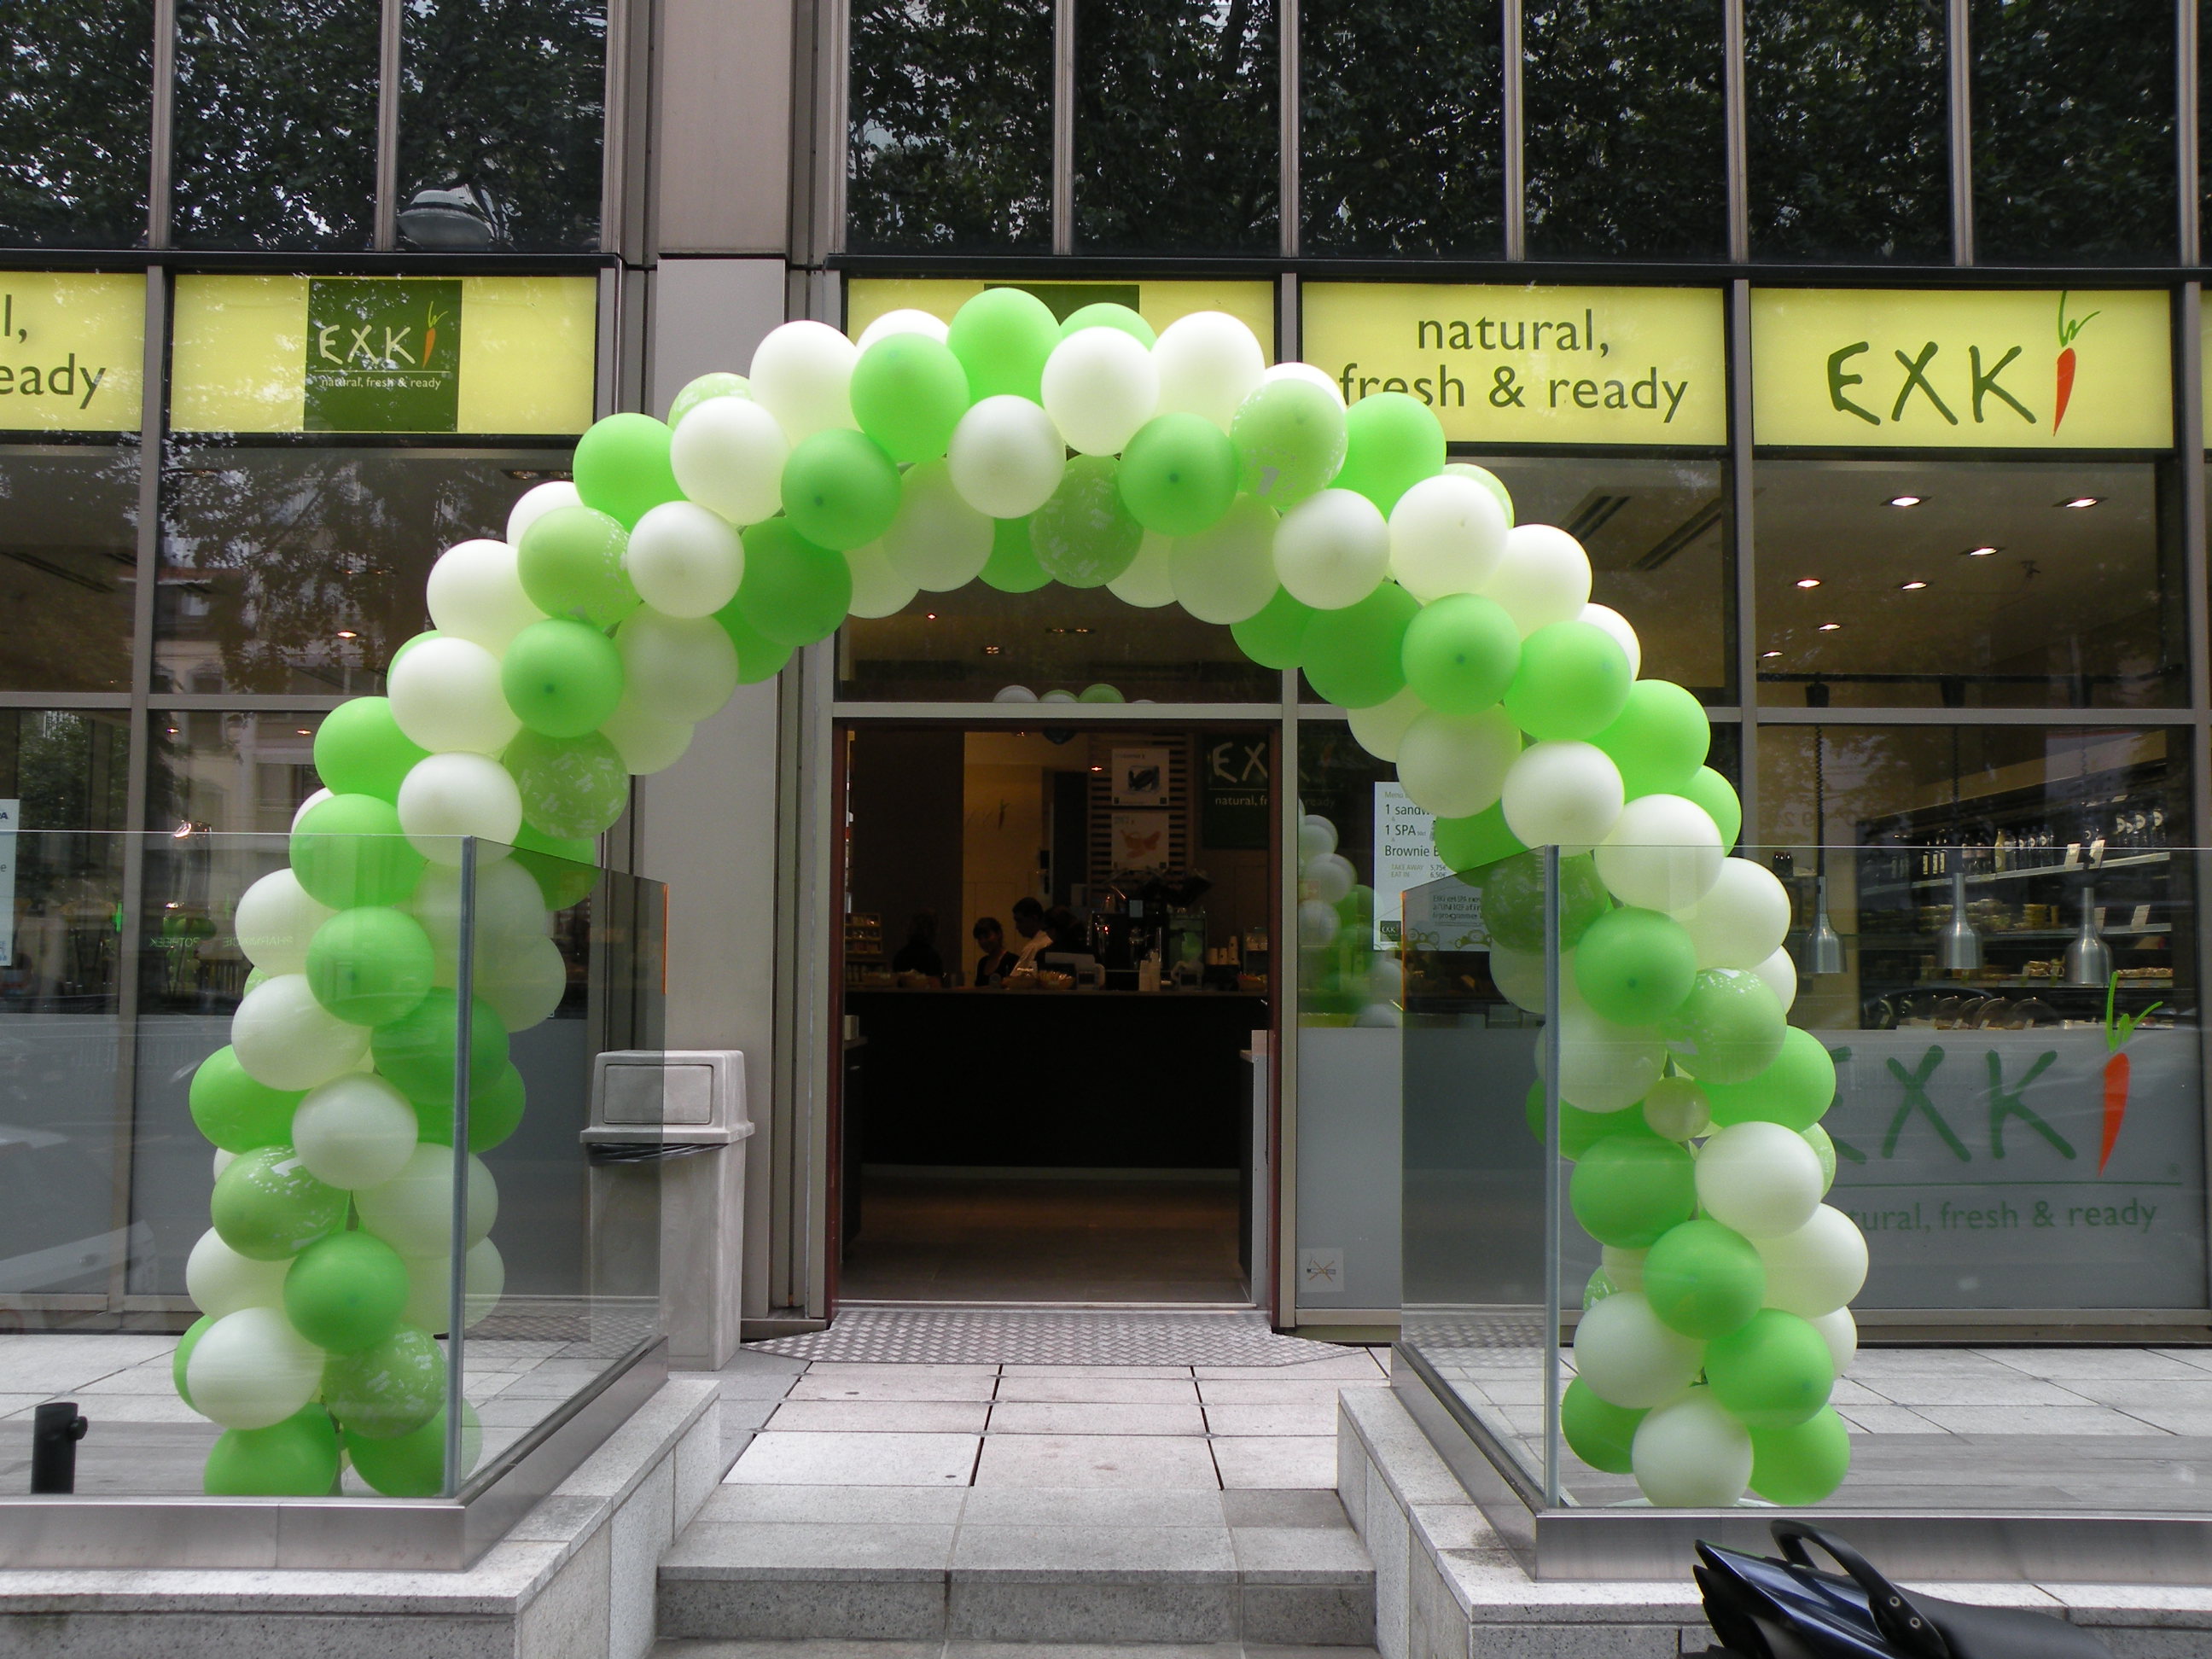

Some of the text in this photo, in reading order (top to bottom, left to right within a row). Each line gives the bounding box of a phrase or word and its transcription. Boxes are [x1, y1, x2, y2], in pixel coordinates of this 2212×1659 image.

[1417, 308, 1610, 358] natural,
[366, 376, 396, 387] fresh
[410, 377, 441, 390] ready
[1488, 366, 1526, 408] &
[1549, 367, 1689, 423] ready
[1214, 795, 1258, 806] natural,
[1385, 824, 1390, 835] 1
[1394, 824, 1417, 835] SPA
[1384, 845, 1430, 857] Brownie
[1940, 1201, 2019, 1230] fresh
[2033, 1200, 2055, 1229] &
[2069, 1197, 2157, 1234] ready
